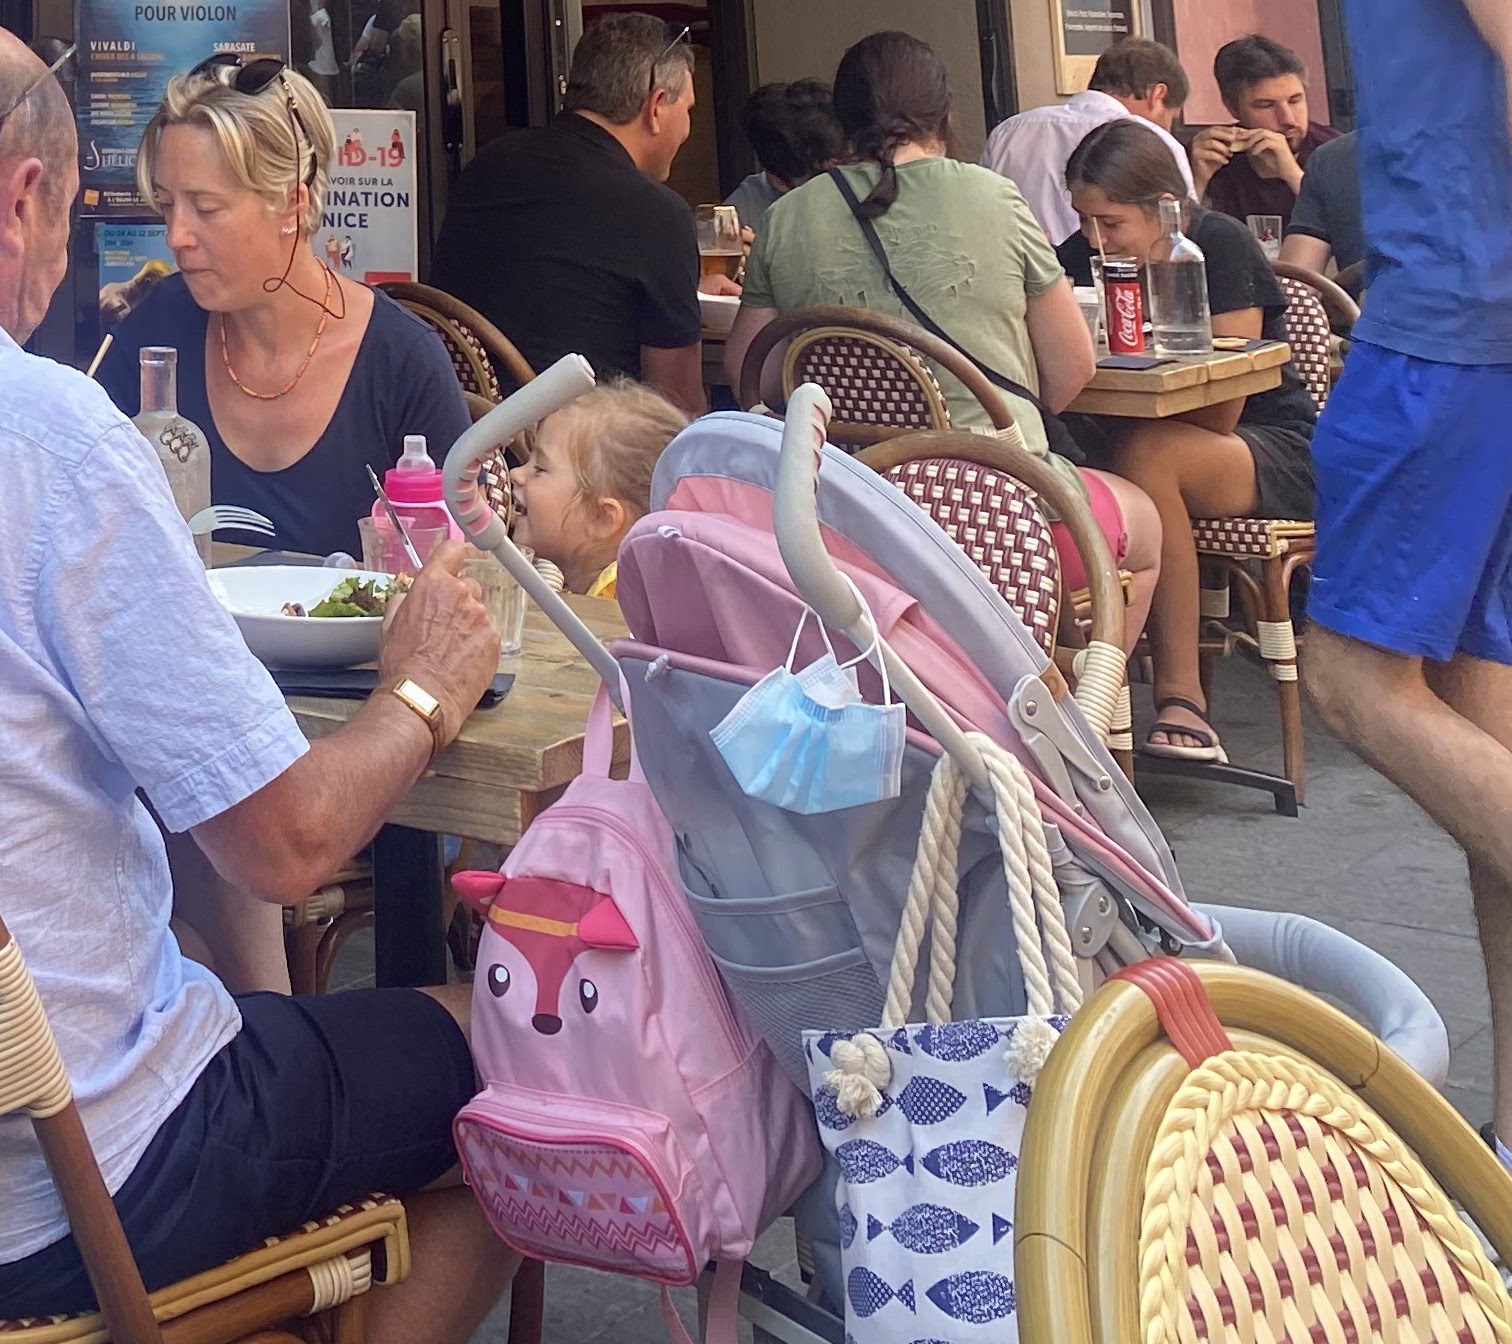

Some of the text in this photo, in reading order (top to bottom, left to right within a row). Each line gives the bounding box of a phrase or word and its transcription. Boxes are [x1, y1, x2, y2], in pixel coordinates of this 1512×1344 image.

[134, 5, 237, 22] POUR VIOLON
[90, 41, 136, 51] VIVALDI
[213, 41, 256, 53] SARASATE
[338, 145, 406, 169] ID-19
[358, 177, 378, 186] SUR
[380, 177, 394, 187] LA
[326, 191, 411, 208] INATION
[322, 212, 369, 229] NICE
[1114, 286, 1139, 347] Coca-Cola
